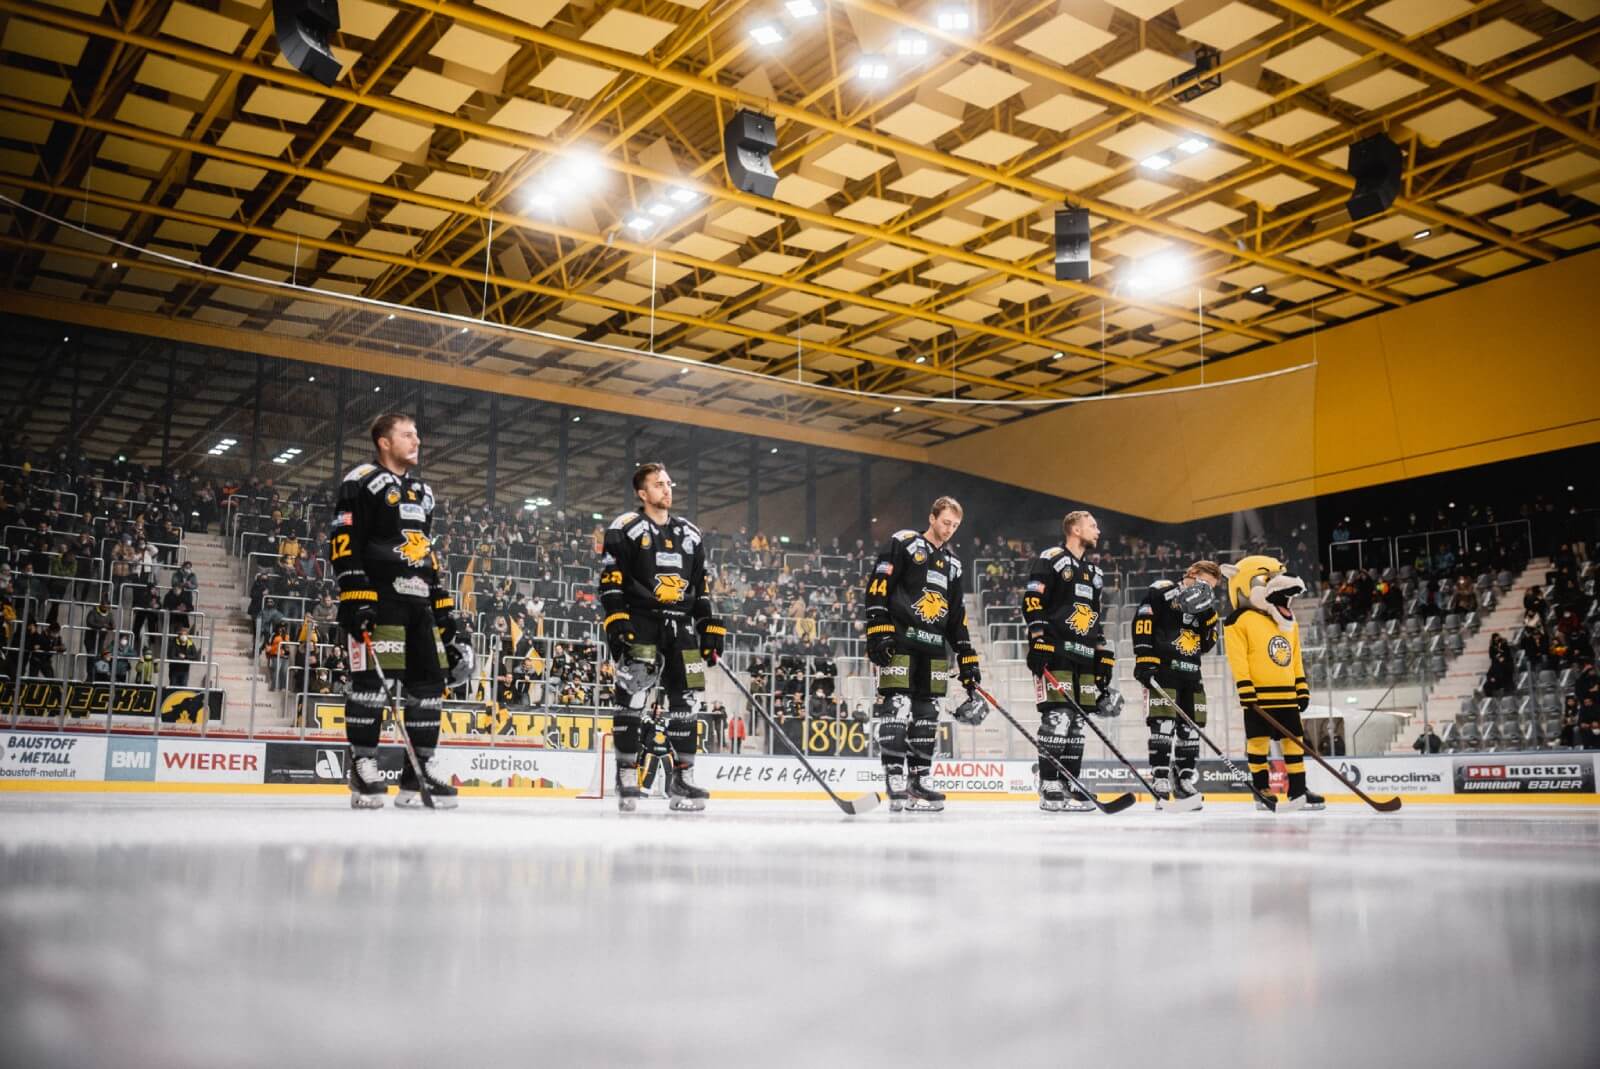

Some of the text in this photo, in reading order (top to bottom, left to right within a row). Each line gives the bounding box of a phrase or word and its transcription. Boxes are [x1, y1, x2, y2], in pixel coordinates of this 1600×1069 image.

[869, 579, 888, 596] 44
[1135, 620, 1152, 634] 60
[7, 735, 77, 750] BAUSTOFF
[802, 719, 865, 755] 1896
[19, 751, 71, 764] METALL
[111, 751, 151, 769] BMI
[163, 752, 258, 771] WIERER
[716, 765, 753, 782] LIFE
[758, 767, 774, 781] IS
[778, 767, 788, 782] A
[932, 763, 1004, 777] AMONN
[1468, 767, 1502, 777] PRO
[1509, 766, 1579, 775] HOCKEY
[1366, 772, 1441, 783] euroclima
[932, 780, 1004, 790] PROFI COLOR
[1463, 780, 1583, 790] WARRIOR BAUER
